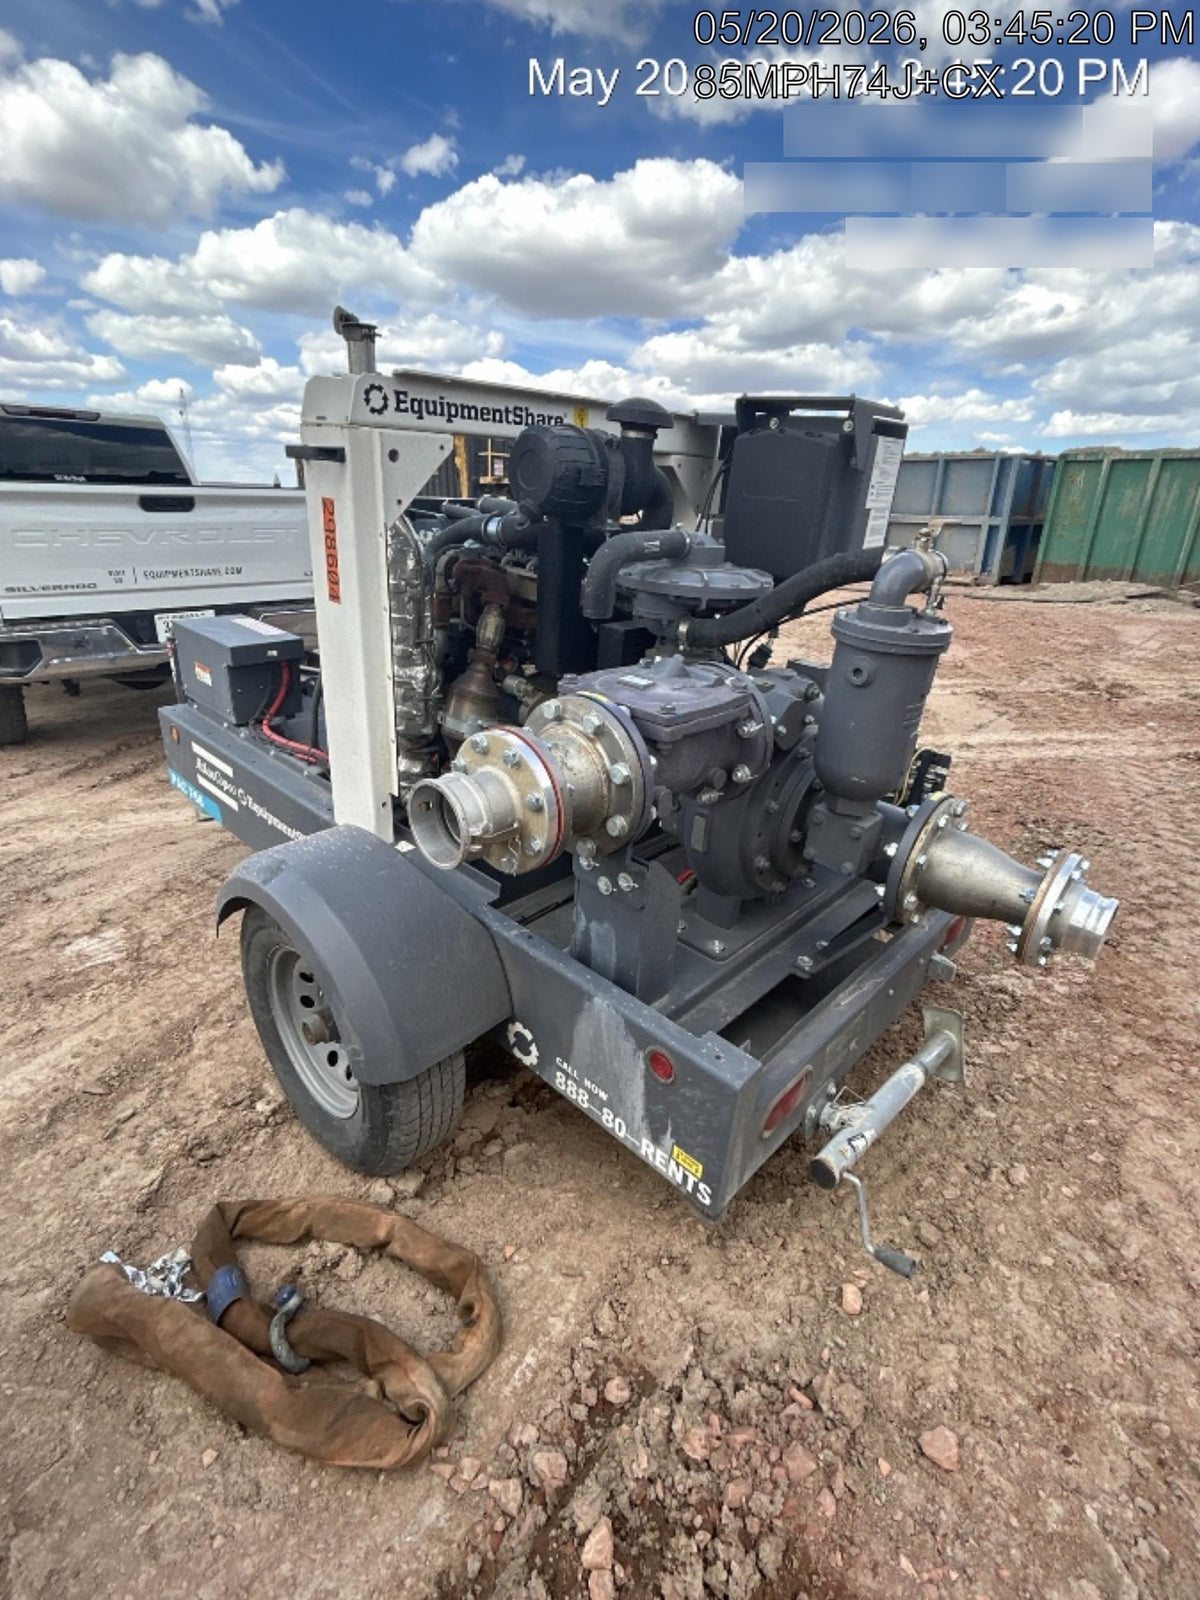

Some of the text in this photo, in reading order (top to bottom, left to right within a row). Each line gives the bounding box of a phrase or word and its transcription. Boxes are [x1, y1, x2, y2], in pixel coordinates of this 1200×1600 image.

[393, 389, 565, 427] EquipmentShare
[11, 527, 300, 547] CHEVROLET
[5, 583, 97, 593] SILVERADO
[556, 1057, 609, 1102] CALL NOW
[555, 1071, 713, 1207] 888-80-RENTS
